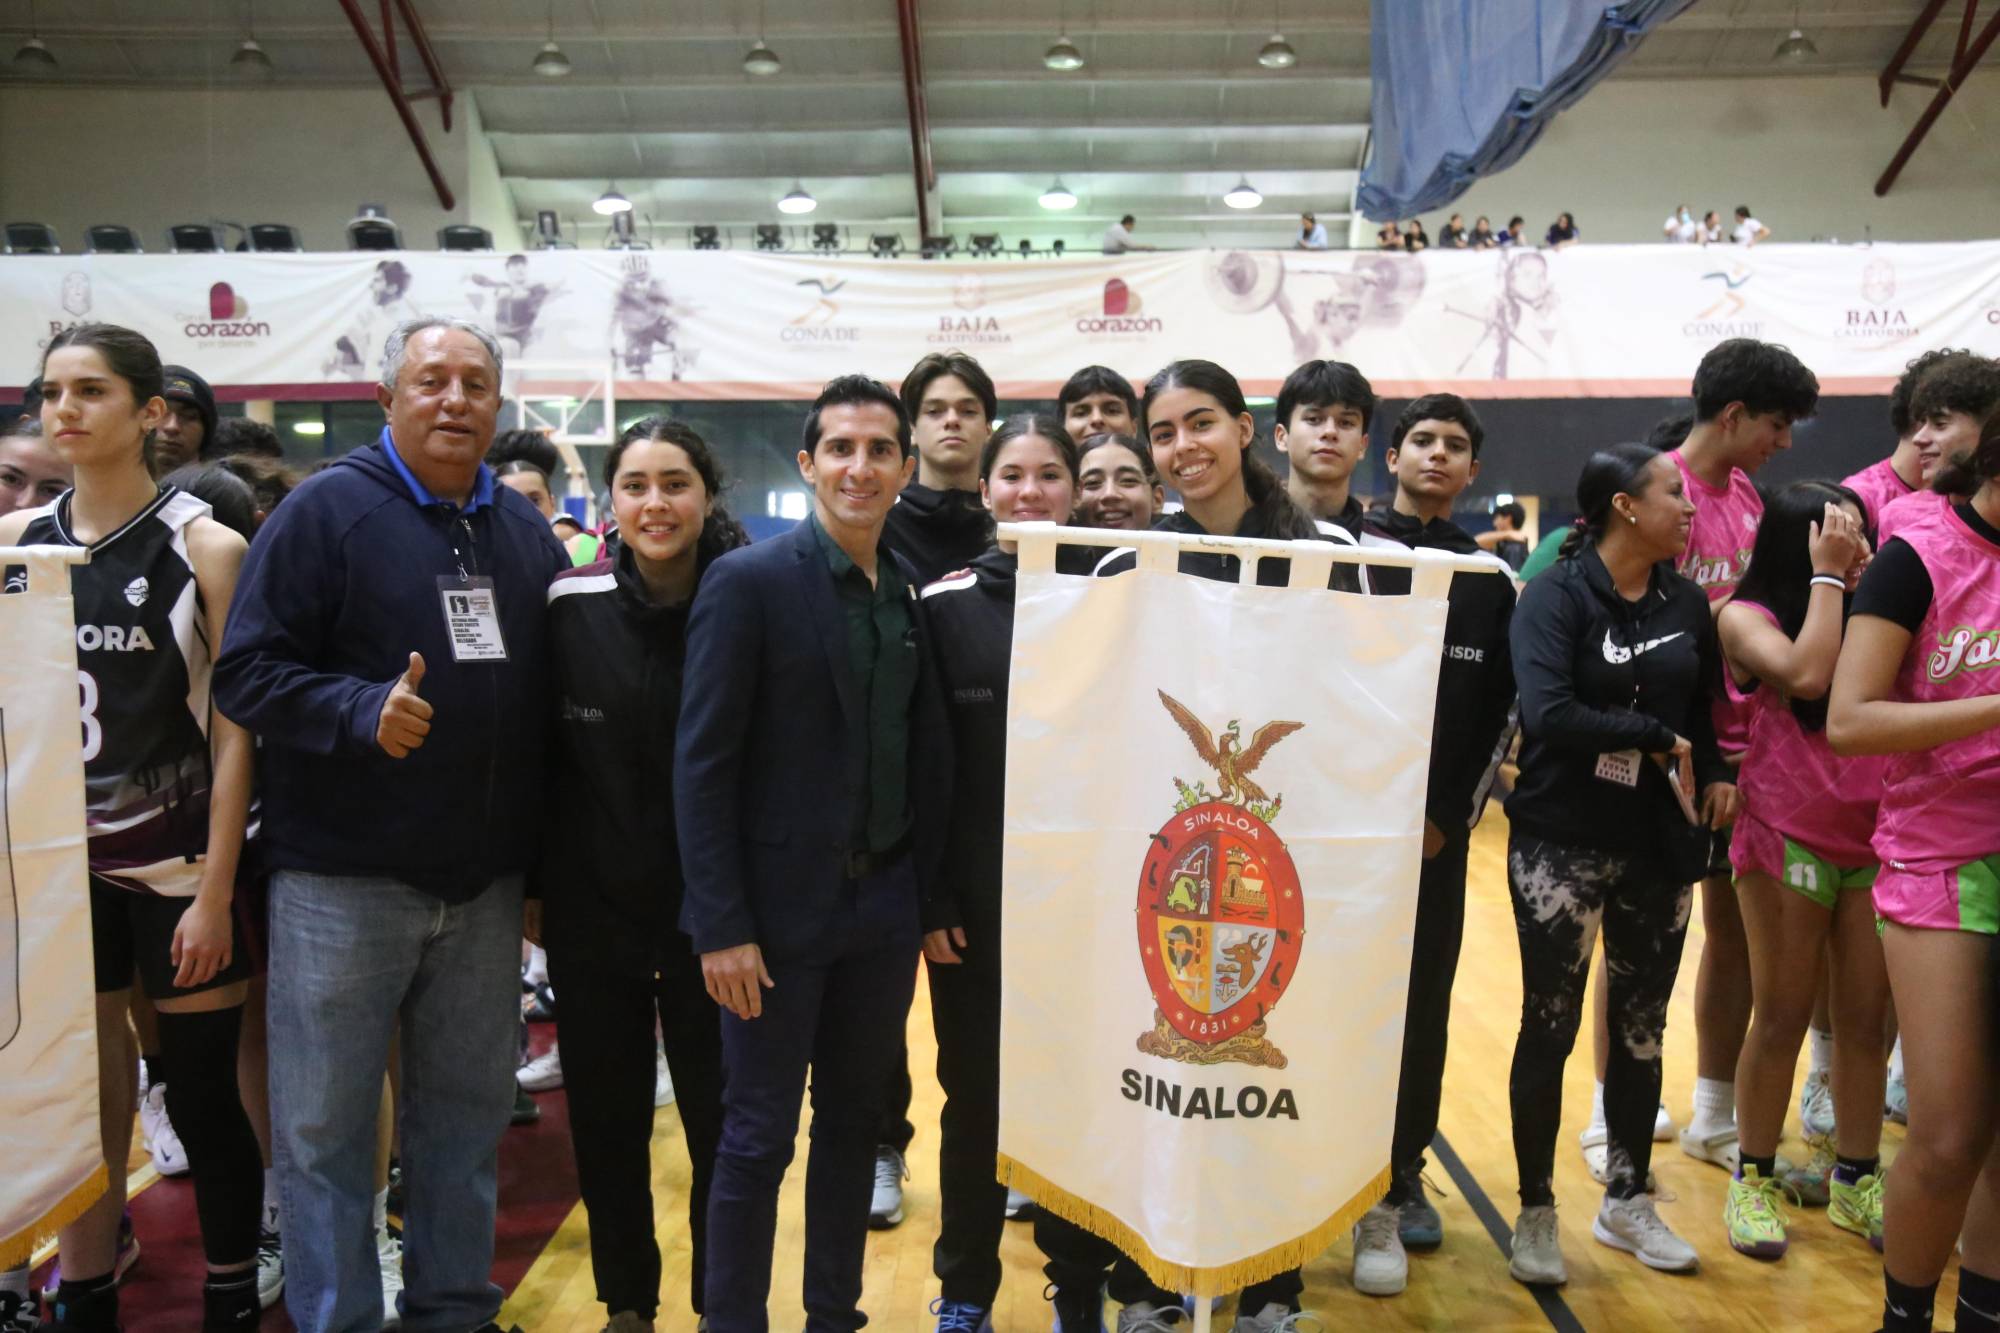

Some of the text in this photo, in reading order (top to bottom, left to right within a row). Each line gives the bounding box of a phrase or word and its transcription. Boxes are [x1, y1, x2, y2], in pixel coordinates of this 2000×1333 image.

[184, 316, 270, 337] corazón
[939, 317, 999, 331] BAJA
[1077, 314, 1162, 333] corazón
[1847, 310, 1907, 325] BAJA
[780, 327, 859, 342] CONADE
[927, 334, 1012, 343] CALIFORNIA
[1834, 328, 1920, 338] CALIFORNIA
[75, 624, 155, 651] ORA
[1450, 645, 1484, 662] ISDE
[1930, 630, 2000, 678] Sa
[1184, 812, 1259, 840] SINALOA
[1788, 863, 1817, 891] 11
[1189, 1019, 1227, 1034] 1831
[1120, 1068, 1300, 1120] SINALOA
